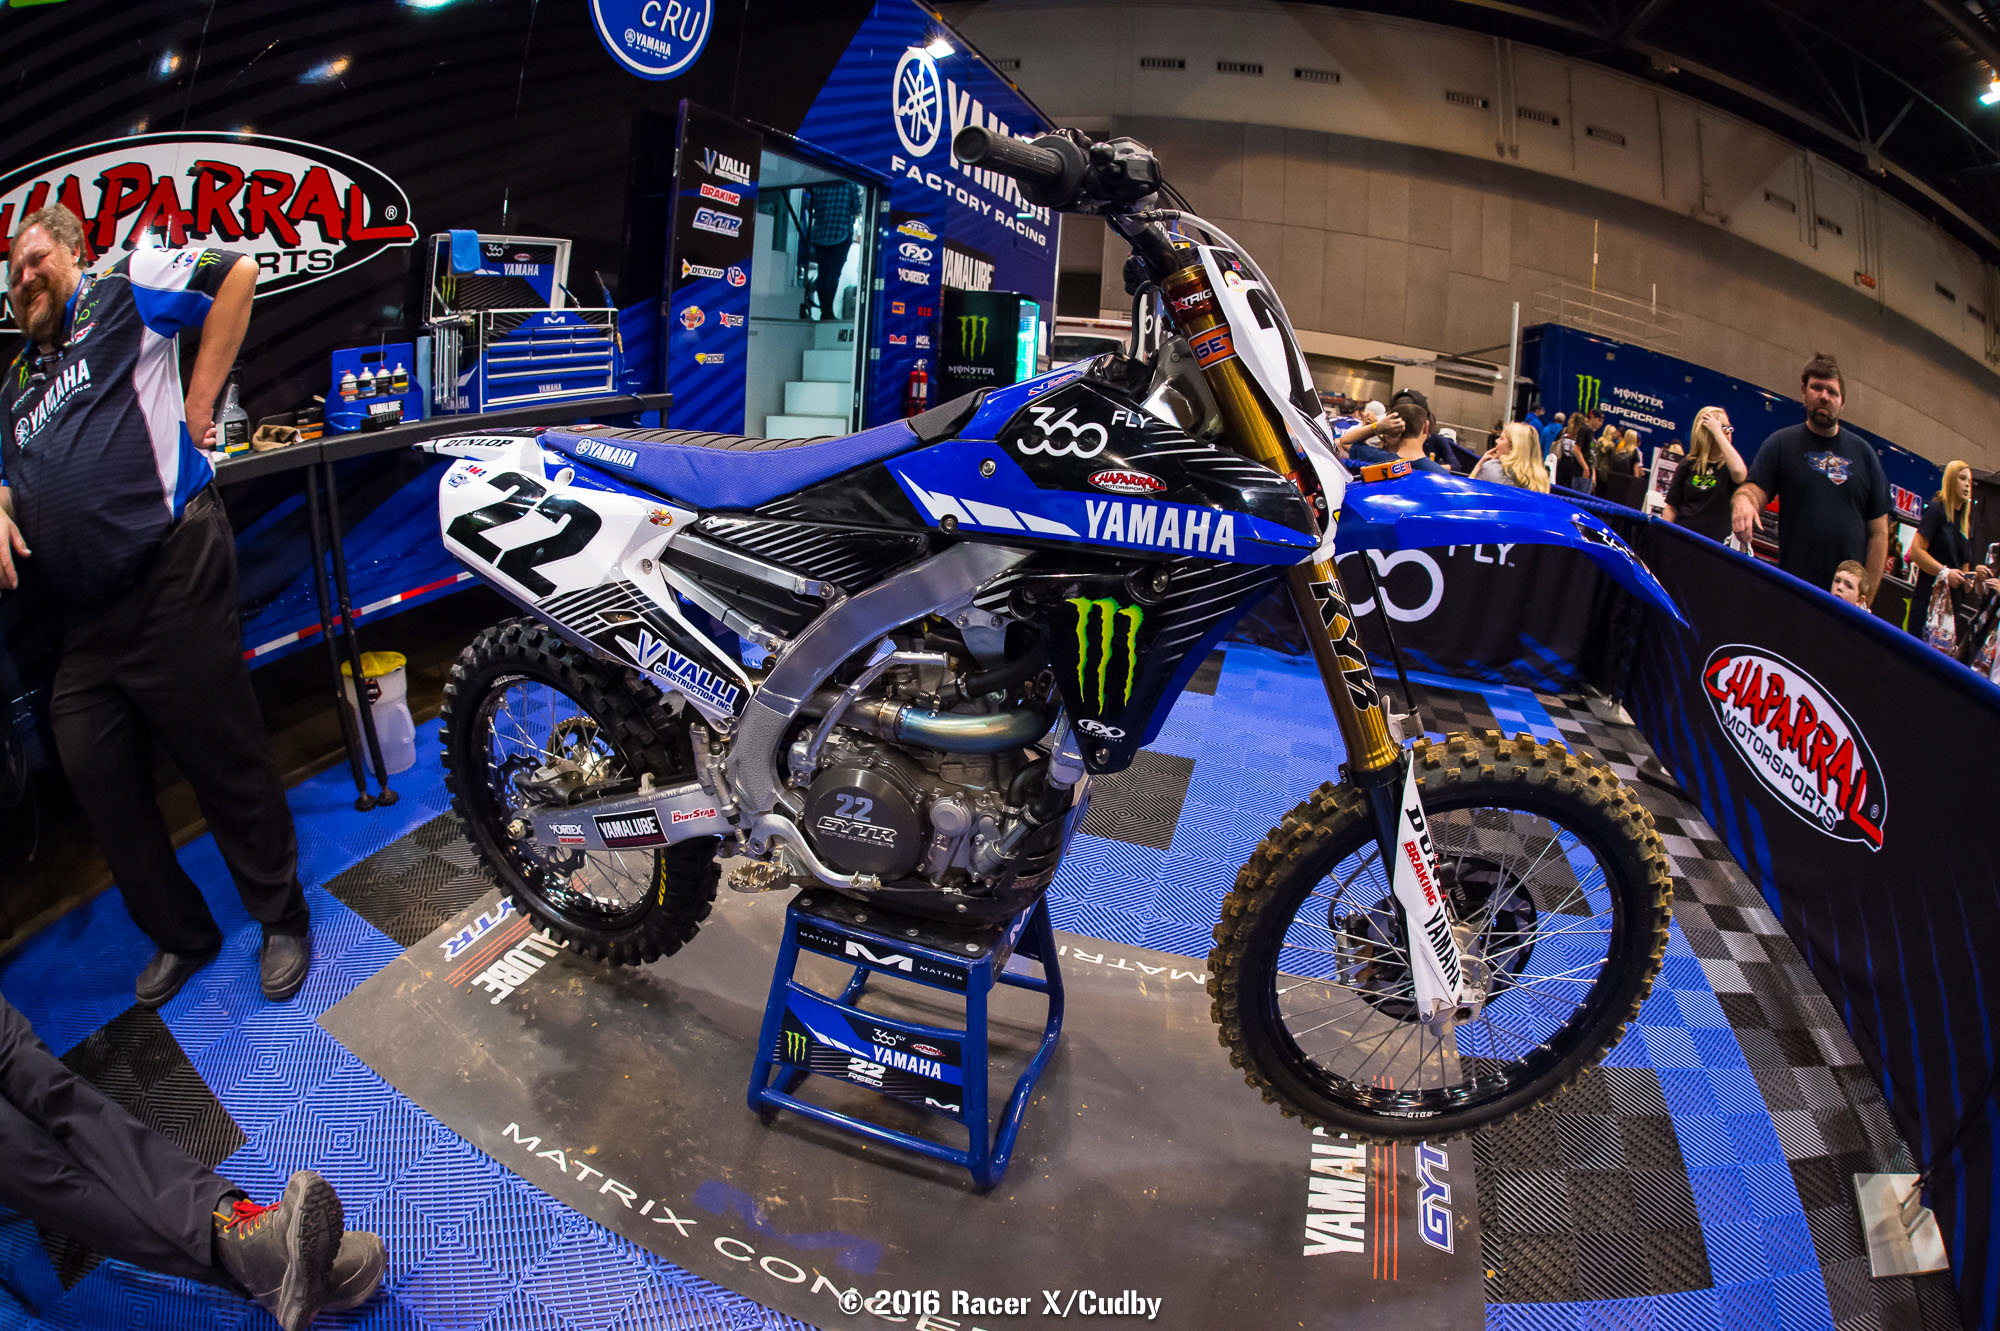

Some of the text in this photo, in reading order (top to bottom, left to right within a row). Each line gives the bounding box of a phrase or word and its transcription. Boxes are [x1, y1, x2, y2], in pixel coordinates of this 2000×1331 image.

[636, 32, 671, 57] YAMAHA
[718, 153, 751, 179] VALLI
[701, 184, 740, 206] BRAKING
[892, 154, 991, 216] FACTORY
[995, 209, 1046, 247] RACING
[696, 208, 742, 232] GYTR
[504, 263, 539, 276] YAMAHA
[691, 265, 724, 278] DUNLOP
[897, 267, 931, 286] VORTEX
[942, 247, 993, 291] YAMALUBE
[1171, 289, 1213, 313] XTRIG
[948, 365, 995, 376] MONSTER
[29, 358, 91, 432] YAMAHA
[538, 383, 562, 393] YAMAHA
[1613, 386, 1664, 410] MONSTER
[1600, 402, 1676, 431] SUPERCROSS
[442, 438, 515, 448] DUNLOP
[1016, 406, 1153, 459] 360 FLY
[587, 440, 639, 470] YAMAHA
[1391, 460, 1412, 475] GET
[459, 463, 487, 479] AMA
[1089, 470, 1168, 491] CHAPARRAL
[446, 471, 603, 600] 22
[1085, 499, 1236, 557] YAMAHA
[1308, 578, 1380, 713] KYB
[654, 662, 735, 714] CONSTRUCTION INC.
[667, 649, 742, 704] VALLI
[1705, 656, 1883, 846] CHAPARRAL
[1722, 709, 1837, 830] MOTORSPORTS
[834, 793, 874, 823] 22
[548, 823, 585, 836] VORTEX
[599, 815, 659, 840] YAMALUBE
[816, 815, 898, 843] GYTR
[1403, 840, 1438, 907] BRAKING
[438, 896, 517, 962] YTR
[800, 930, 839, 947] MATRIX
[919, 965, 963, 981] MATRIX
[1424, 907, 1462, 992] YAMAHA
[1058, 945, 1206, 985] MATRI
[872, 1028, 906, 1046] 360 FLY
[847, 1057, 887, 1080] 22
[873, 1045, 942, 1080] YAMAHA
[848, 1072, 884, 1087] REED
[501, 1121, 698, 1238] MATRIX
[1415, 1141, 1454, 1255] GYT
